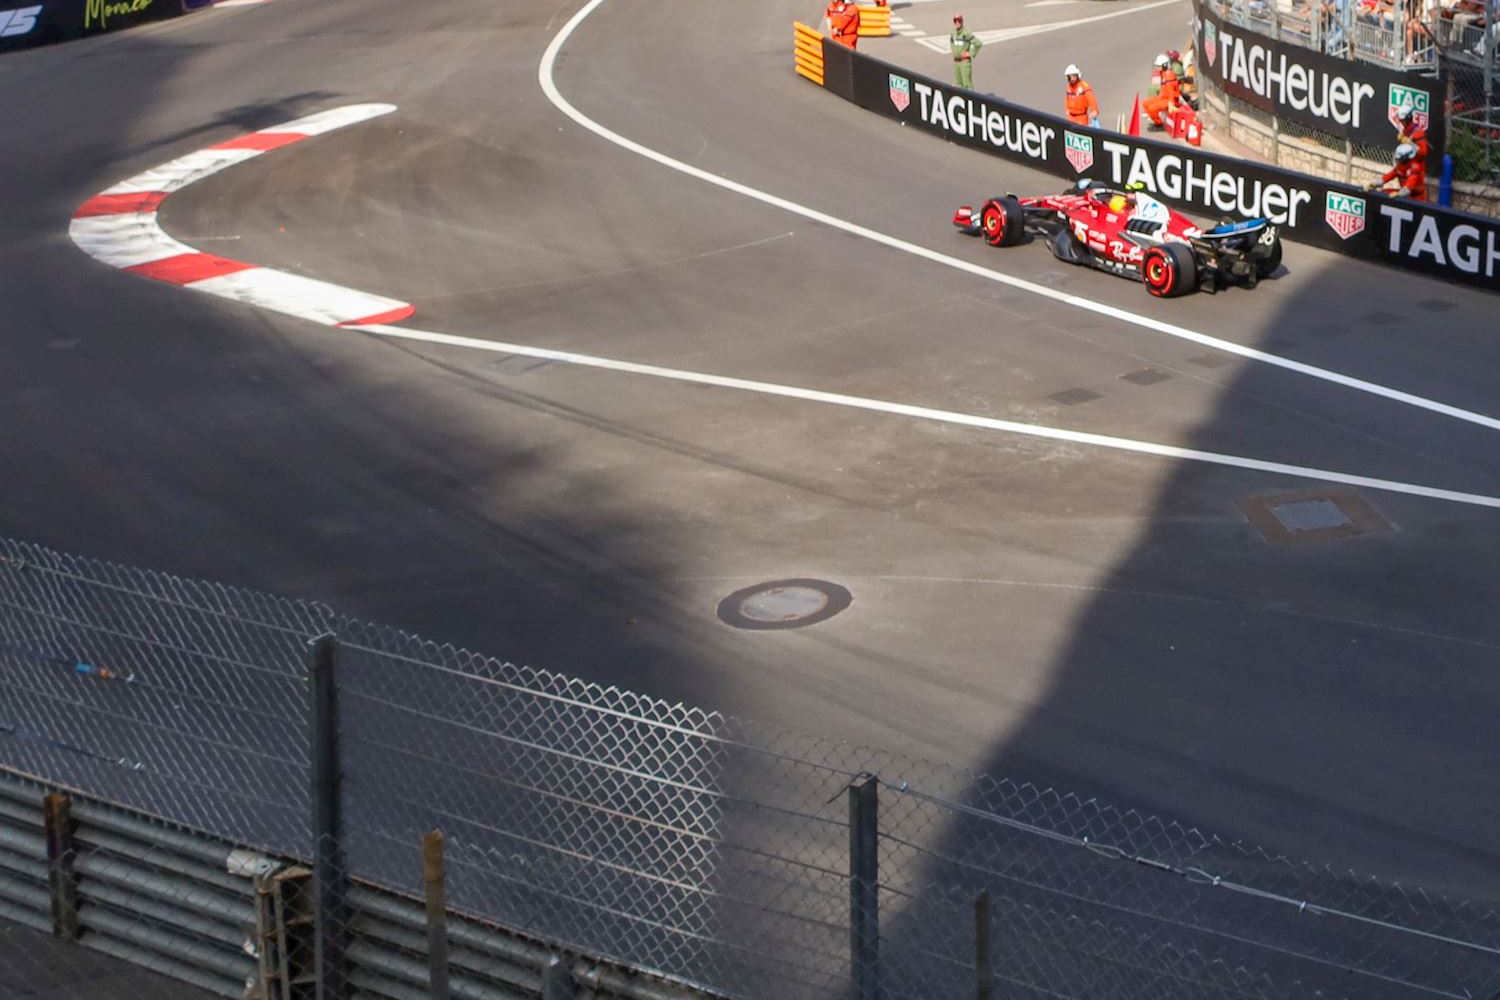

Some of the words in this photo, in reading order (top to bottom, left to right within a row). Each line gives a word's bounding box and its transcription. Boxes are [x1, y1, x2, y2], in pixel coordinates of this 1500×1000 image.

[1392, 89, 1426, 110] TAG
[1066, 135, 1090, 151] TAG
[1330, 195, 1362, 216] TAG
[1327, 211, 1363, 235] HEUER
